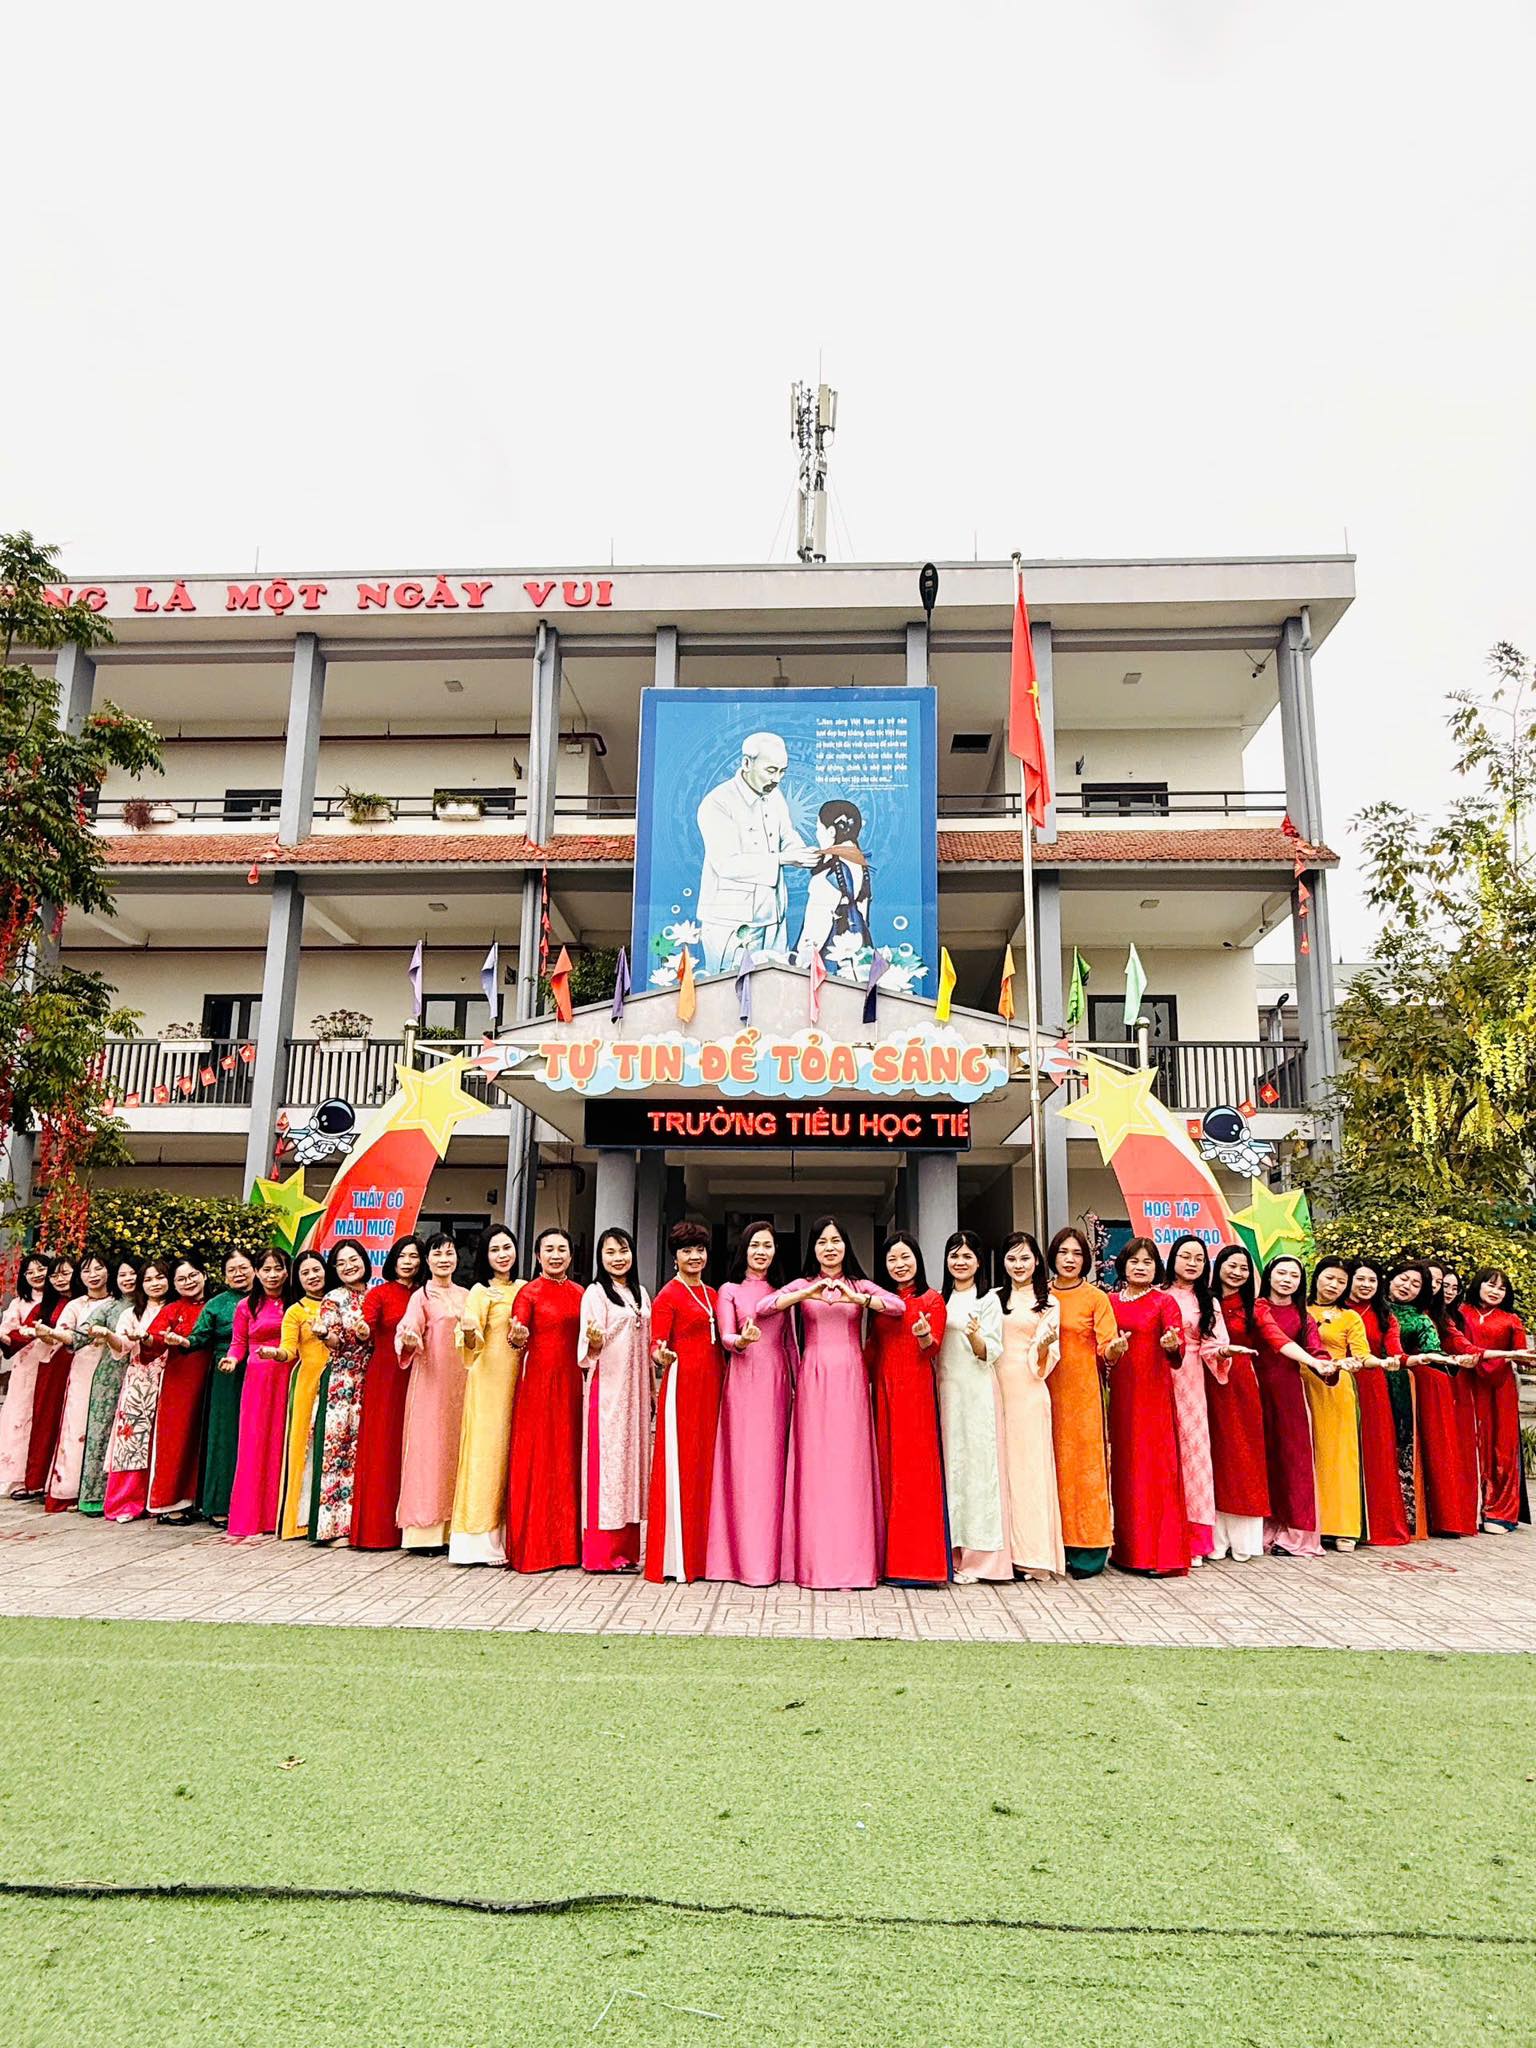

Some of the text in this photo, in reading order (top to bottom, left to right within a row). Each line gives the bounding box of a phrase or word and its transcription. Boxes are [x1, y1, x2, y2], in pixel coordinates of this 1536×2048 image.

[134, 578, 196, 612] LÀ
[225, 576, 328, 616] MỘT
[357, 574, 494, 611] NGÀY
[522, 580, 614, 608] VUI
[539, 1028, 990, 1089] TỰ TIN ĐỂ TỎA SÁNG
[647, 1105, 777, 1136] TRƯỜNG
[785, 1106, 850, 1136] TIỂU
[859, 1112, 922, 1142] HỌC
[387, 1188, 404, 1209] CÔ
[1143, 1198, 1201, 1221] HỌC TẬP
[335, 1212, 395, 1240] MẪU MỰC
